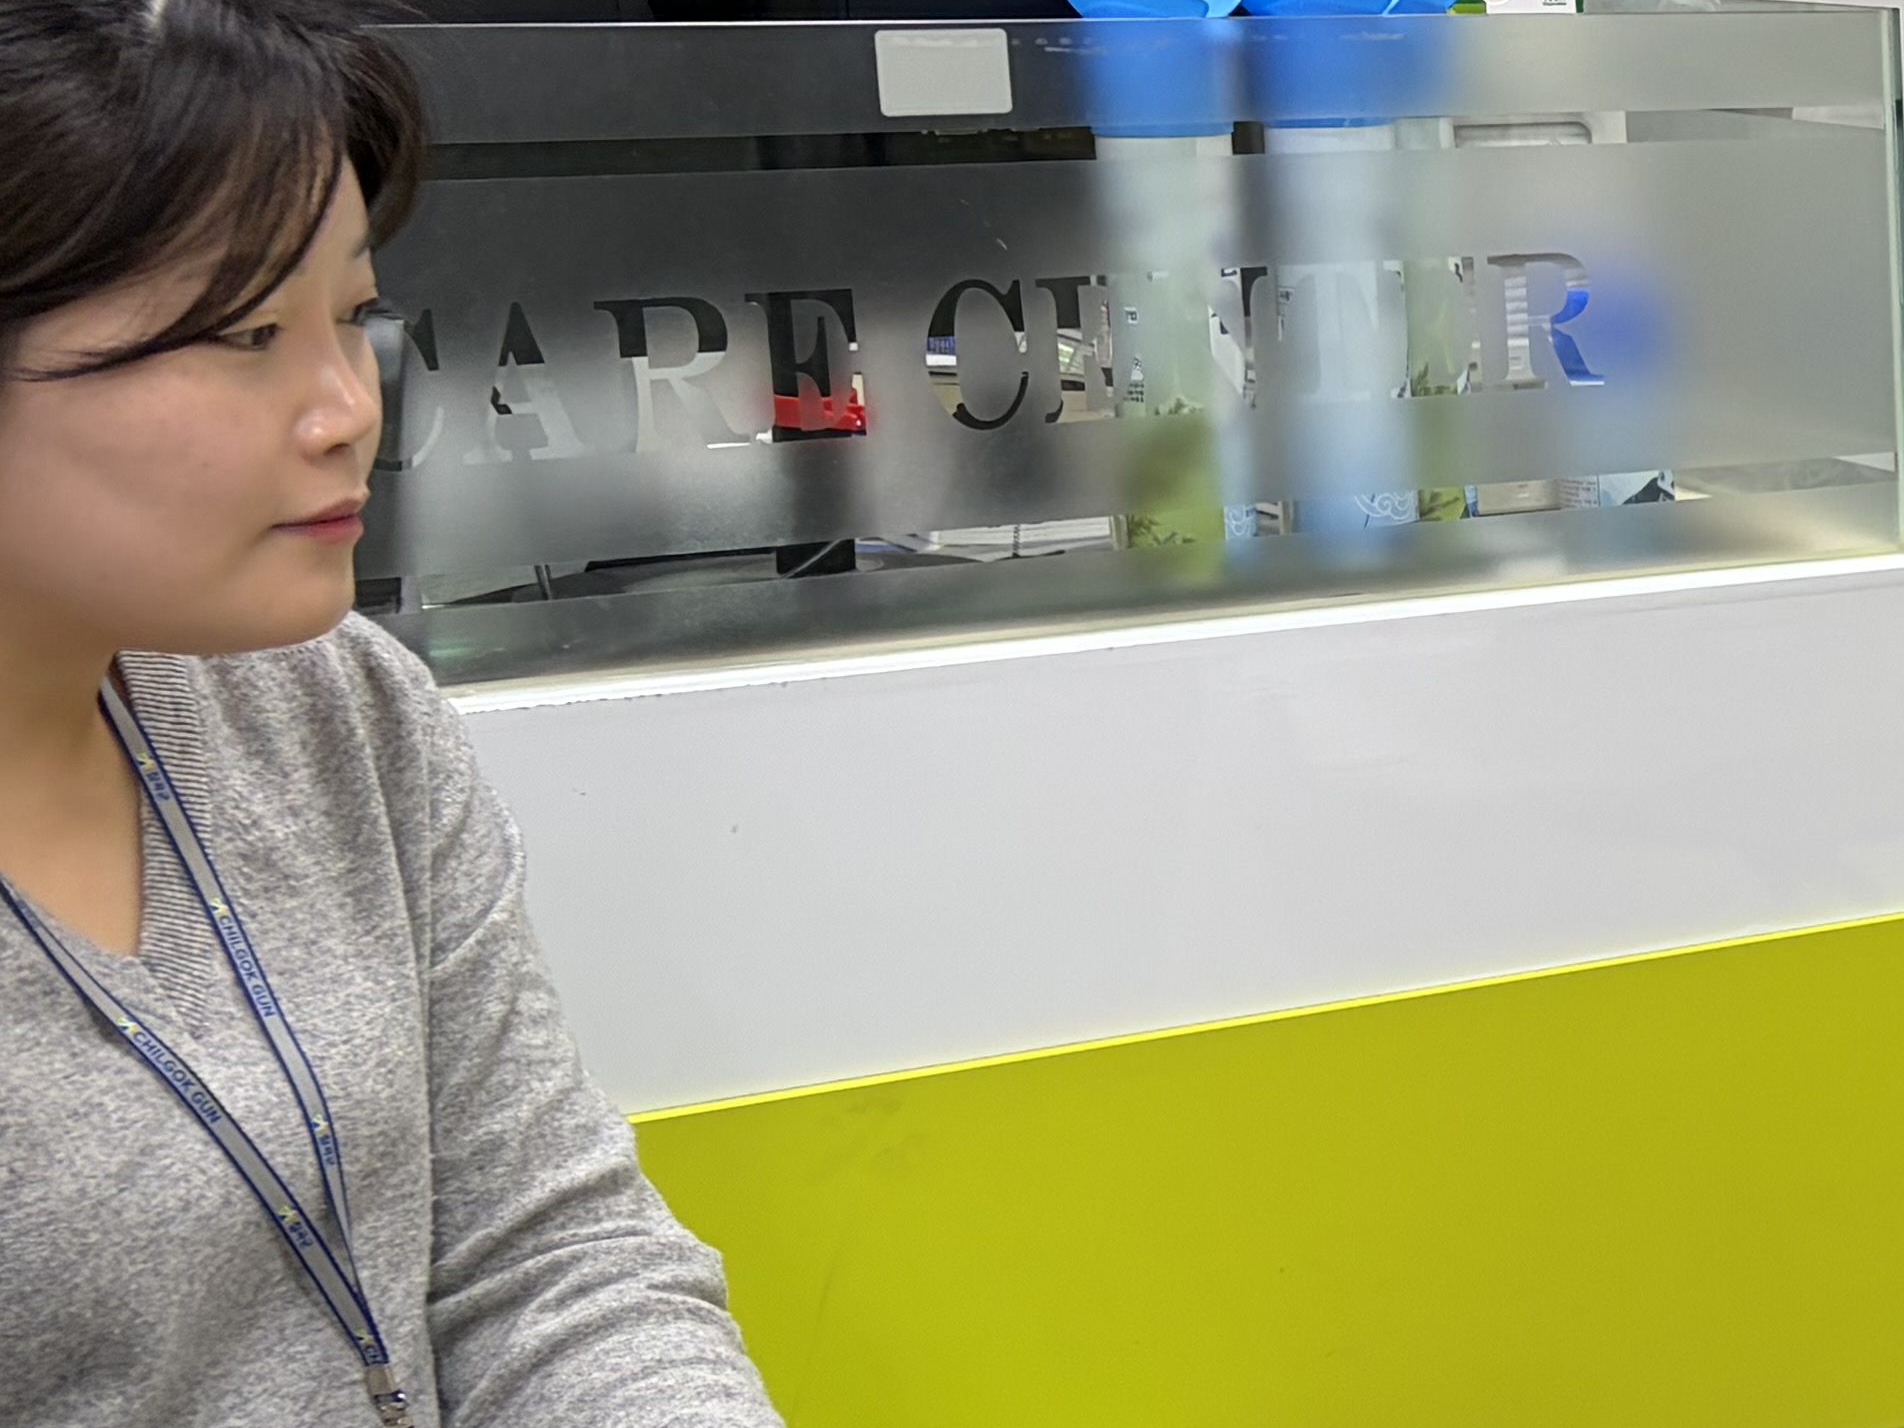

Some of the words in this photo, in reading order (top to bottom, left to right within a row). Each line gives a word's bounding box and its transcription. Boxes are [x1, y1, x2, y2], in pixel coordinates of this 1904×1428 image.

[220, 914, 258, 983] CHILGOK
[251, 983, 276, 1019] GUN
[133, 1030, 196, 1092] CHILGOK
[191, 1090, 222, 1124] GUN
